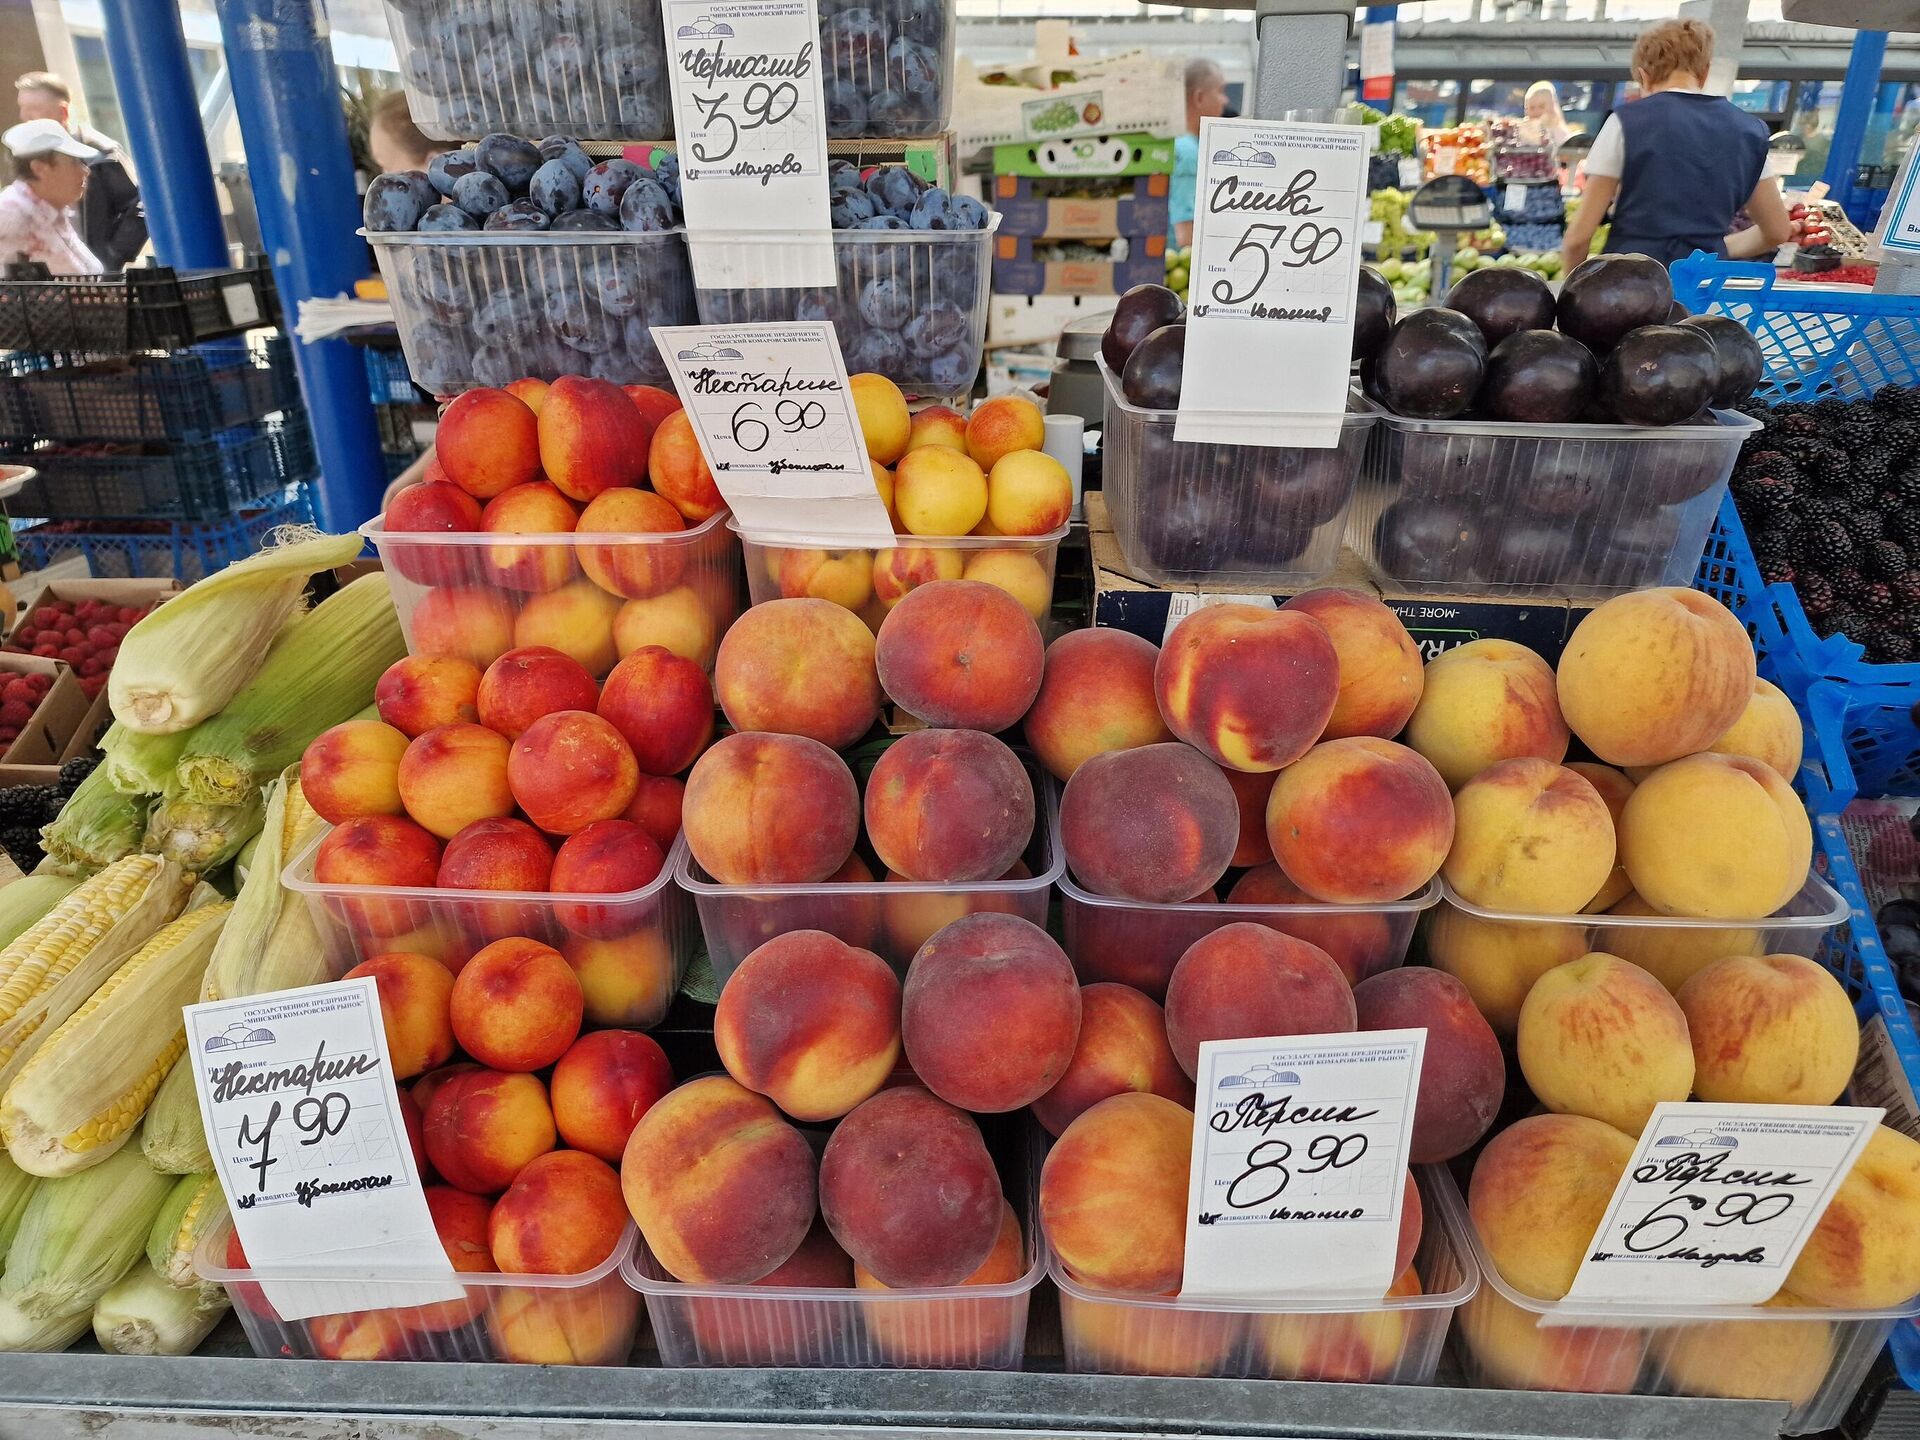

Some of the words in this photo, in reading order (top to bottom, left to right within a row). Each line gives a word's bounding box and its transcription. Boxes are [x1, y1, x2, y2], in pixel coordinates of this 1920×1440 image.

[679, 40, 814, 89] Чернослив
[690, 131, 707, 139] Цена
[1254, 133, 1313, 142] ГОСУДАРСТВЕННОЕ
[1314, 136, 1359, 145] ПРЕДПРИЯТИЕ
[1287, 142, 1334, 150] КОМАРОВСКИЙ
[1210, 169, 1324, 216] Слива
[1208, 265, 1227, 273] Цена
[244, 1001, 310, 1017] ГОСУДАРСТВЕННОЕ
[310, 993, 361, 1007] ПРЕДПРИЯТИЕ
[283, 1005, 337, 1020] КОМАРОВСКИЙ
[1272, 1051, 1350, 1060] ГОСУДАРСТВЕННОЕ
[1350, 1048, 1408, 1056] ПРЕДПРИЯТИЕ
[1315, 1057, 1376, 1065] КОМАРОВСКИЙ
[211, 1040, 381, 1103] Нектарин
[1210, 1093, 1379, 1136] Персик
[1717, 1120, 1796, 1129] ГОСУДАРСТВЕННОЕ
[1796, 1123, 1855, 1131] ПРЕДПРИЯТИЕ
[1759, 1128, 1822, 1136] КОМАРОВСКИЙ
[232, 1155, 254, 1164] Цена
[1633, 1150, 1813, 1194] Персик
[1214, 1178, 1232, 1186] Цен
